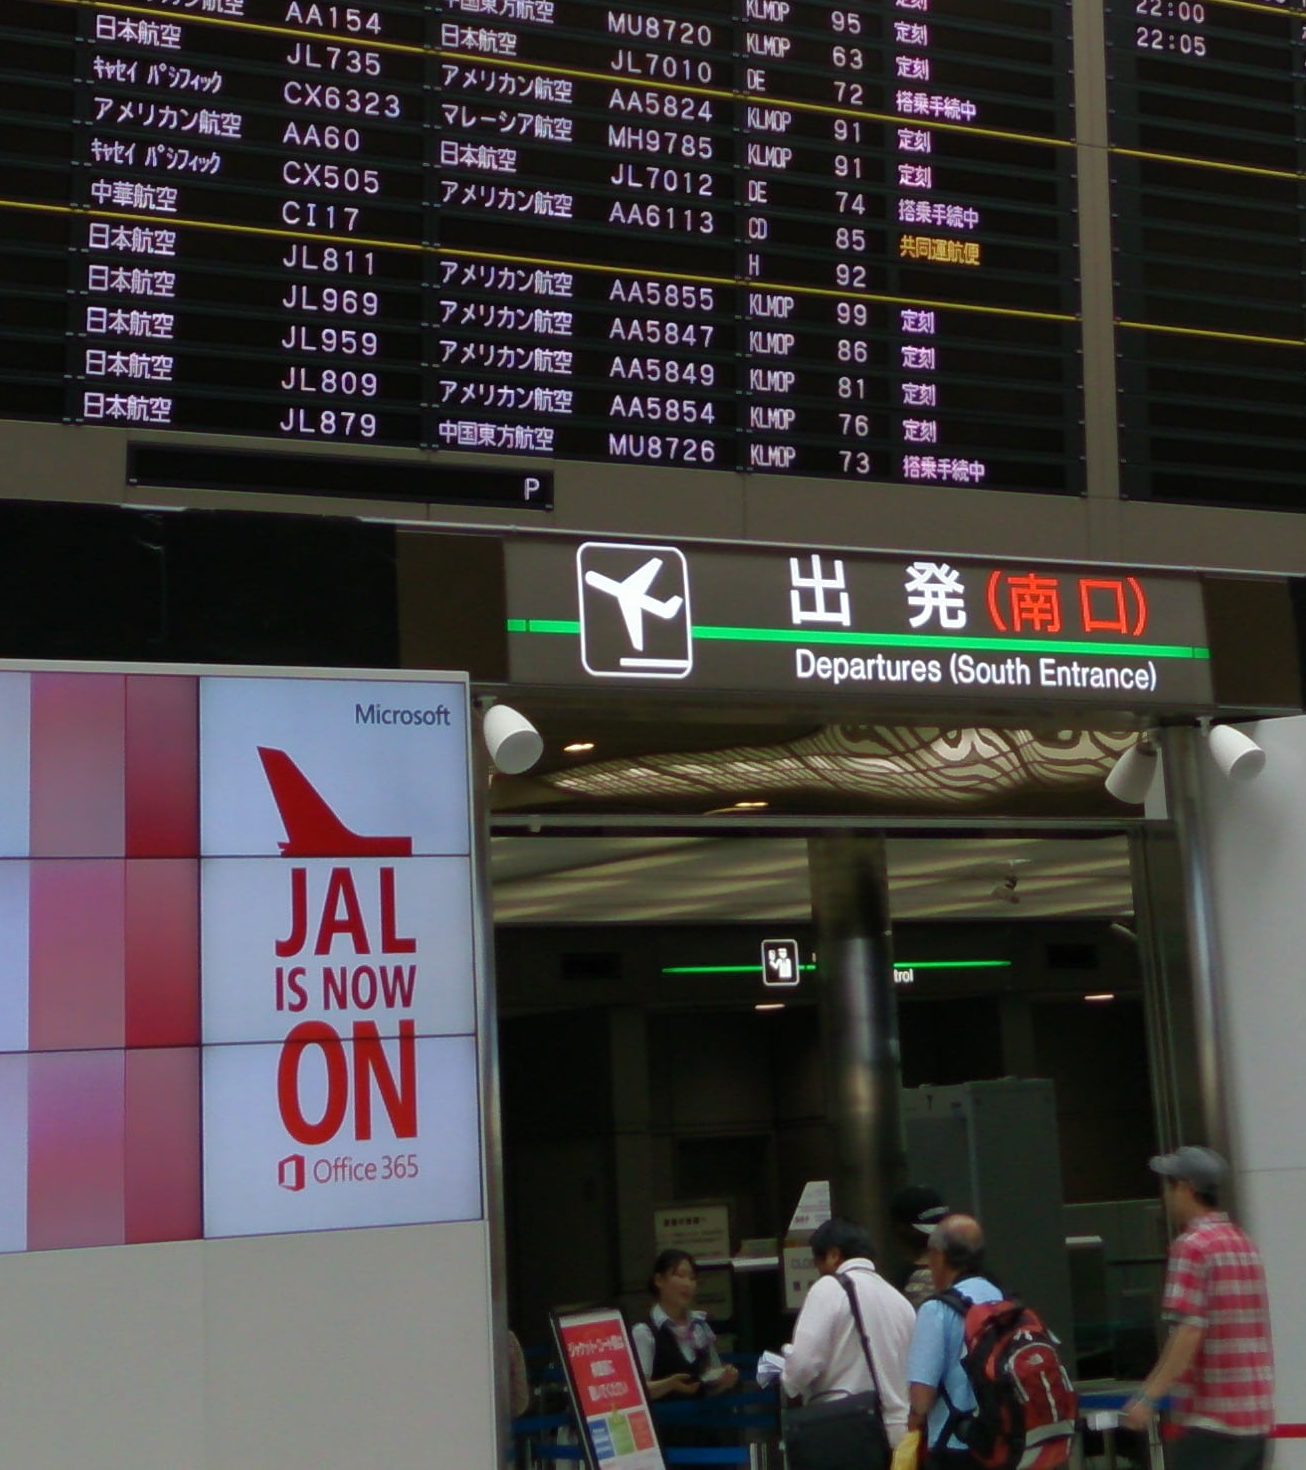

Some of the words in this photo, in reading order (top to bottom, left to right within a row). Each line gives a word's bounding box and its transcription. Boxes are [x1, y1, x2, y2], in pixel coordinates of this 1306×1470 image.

[606, 9, 713, 48] MU8720
[1135, 25, 1207, 58] 22:05
[284, 0, 383, 36] AA154
[832, 80, 864, 106] 72
[282, 80, 402, 120] CX6323
[90, 177, 179, 213] 中華航空
[281, 199, 360, 232] CI17
[280, 324, 378, 358] JL959
[279, 406, 377, 438] JL879
[607, 432, 716, 463] MU8726
[789, 553, 968, 630] 出発
[795, 648, 942, 684] Departures
[950, 650, 1031, 687] (South
[1039, 655, 1158, 691] Entrance)
[354, 702, 452, 727] Microsoft
[274, 866, 417, 958] JAL
[275, 965, 308, 1013] IS
[323, 963, 417, 1011] NOW
[276, 1018, 419, 1146] ON
[313, 1158, 378, 1186] Office
[381, 1153, 420, 1181] 365
